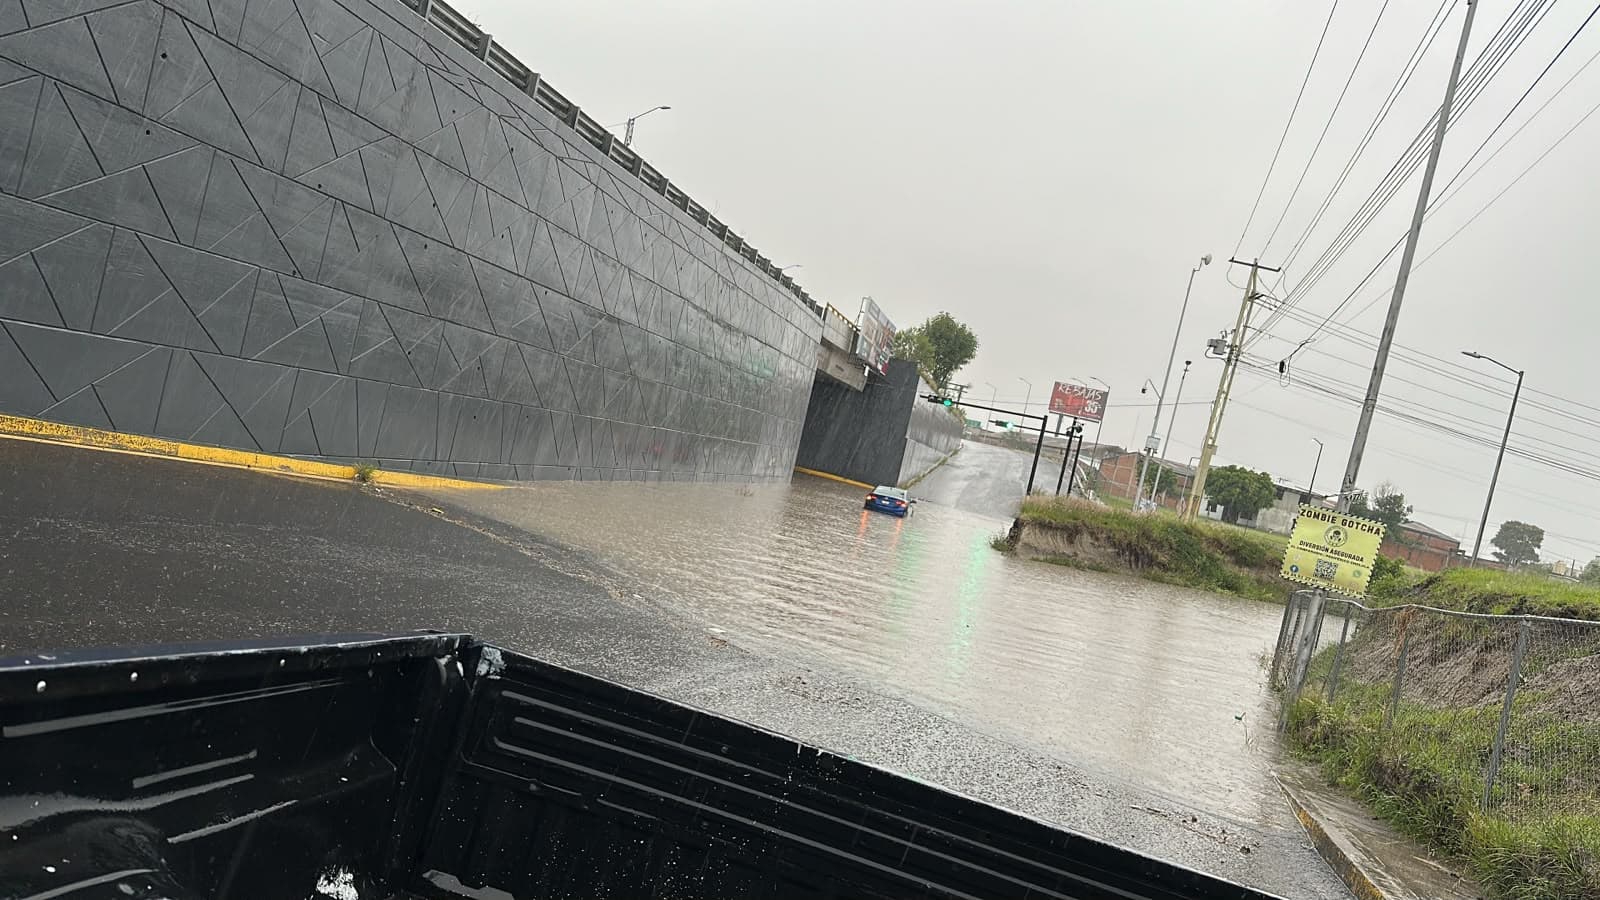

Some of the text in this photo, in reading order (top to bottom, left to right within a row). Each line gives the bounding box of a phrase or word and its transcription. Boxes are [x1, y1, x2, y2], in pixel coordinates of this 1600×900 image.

[1300, 508, 1381, 536] ZOMBIE GOTCHA
[1299, 540, 1329, 553] DIVERSIÓN
[1330, 549, 1364, 562] ASEGURADA
